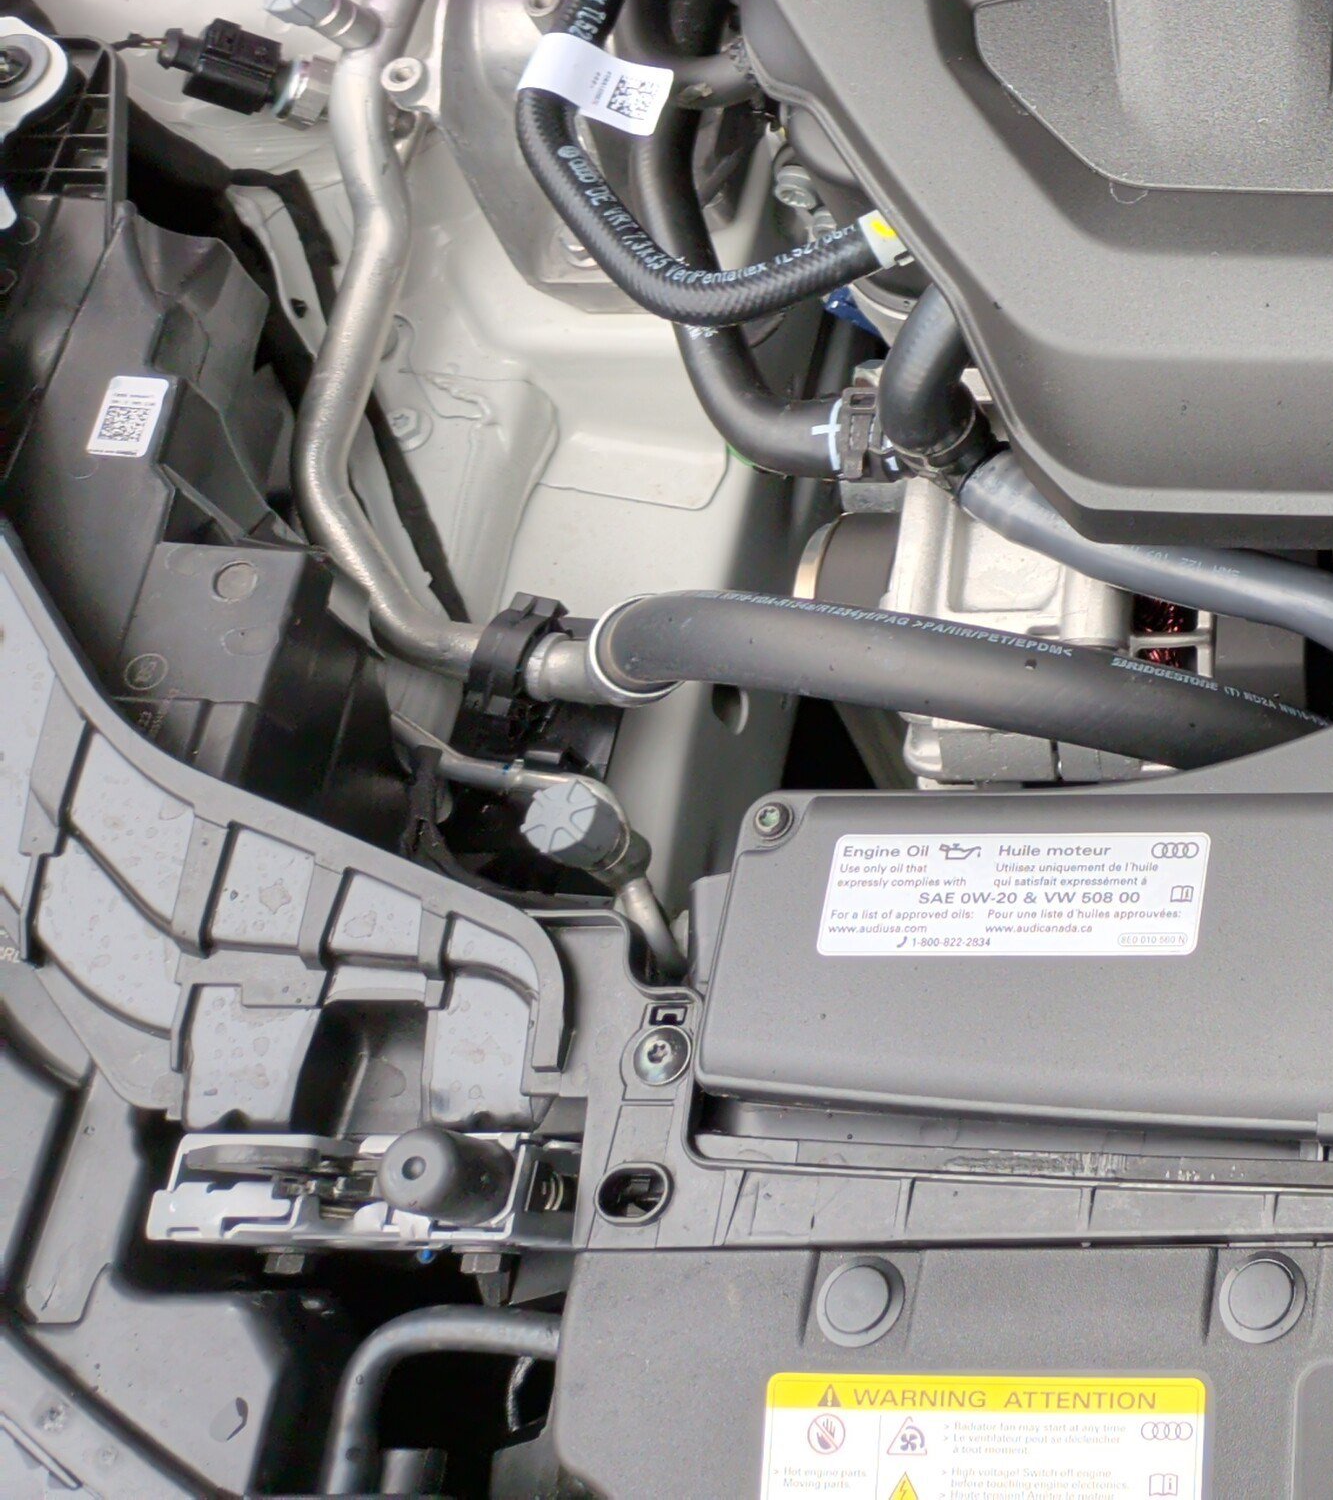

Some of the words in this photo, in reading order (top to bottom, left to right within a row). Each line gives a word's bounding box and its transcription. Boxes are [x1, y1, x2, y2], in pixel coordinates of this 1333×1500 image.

[584, 184, 613, 207] DE
[1111, 656, 1218, 692] BRIDGESTONE
[843, 844, 901, 860] Engine
[906, 844, 930, 857] Oil
[998, 844, 1041, 857] Huile
[1047, 844, 1111, 857] moteur
[840, 863, 859, 873] Use
[863, 863, 887, 874] only
[890, 863, 903, 873] oil
[906, 863, 927, 873] that
[996, 862, 1035, 873] Utilisez
[1038, 863, 1100, 874] uniquement
[1103, 862, 1122, 873] de
[1124, 861, 1159, 873] l'huile
[837, 877, 889, 888] expressly
[891, 877, 941, 888] complies
[943, 877, 967, 888] with
[993, 877, 1012, 888] qui
[1014, 876, 1057, 887] satisfait
[919, 892, 955, 904] SAE
[961, 892, 1018, 904] 0W-20
[1023, 892, 1037, 904] &
[1044, 892, 1077, 904] VW
[1081, 892, 1114, 904] 508
[1118, 891, 1141, 904] 00
[831, 909, 849, 920] For
[851, 910, 858, 920] a
[861, 909, 877, 920] list
[881, 909, 893, 920] of
[896, 909, 947, 921] approved
[951, 909, 975, 920] oils:
[987, 909, 1014, 919] Pour
[1017, 910, 1037, 919] une
[1040, 909, 1063, 919] liste
[1066, 908, 1110, 919] d'huiles
[1114, 908, 1182, 921] approuvées:
[828, 924, 928, 934] www.audiusa.com
[985, 924, 1093, 934] www.audicanada.ca
[912, 937, 991, 947] 1-800-822-2834
[853, 1388, 986, 1409] WARNING
[1004, 1390, 1156, 1410] ATTENTION
[954, 1422, 997, 1432] Radiator
[1000, 1423, 1015, 1432] fan
[1018, 1424, 1039, 1434] may
[1043, 1424, 1066, 1432] start
[1071, 1424, 1079, 1432] at
[1082, 1424, 1100, 1434] any
[953, 1434, 966, 1443] Le
[969, 1434, 1021, 1443] ventilateur
[1025, 1435, 1048, 1444] peut
[1051, 1436, 1061, 1444] se
[962, 1446, 981, 1454] tout
[784, 1467, 802, 1477] Hot
[804, 1468, 838, 1478] engine
[951, 1468, 975, 1481] High
[1023, 1468, 1058, 1477] Switch
[1060, 1468, 1073, 1477] off
[1077, 1469, 1111, 1480] engine
[783, 1478, 821, 1489] Moving
[951, 1479, 983, 1488] before
[986, 1480, 1031, 1490] touching
[1034, 1481, 1068, 1491] engine
[950, 1491, 980, 1500] Haute
[1066, 1492, 1076, 1500] le
